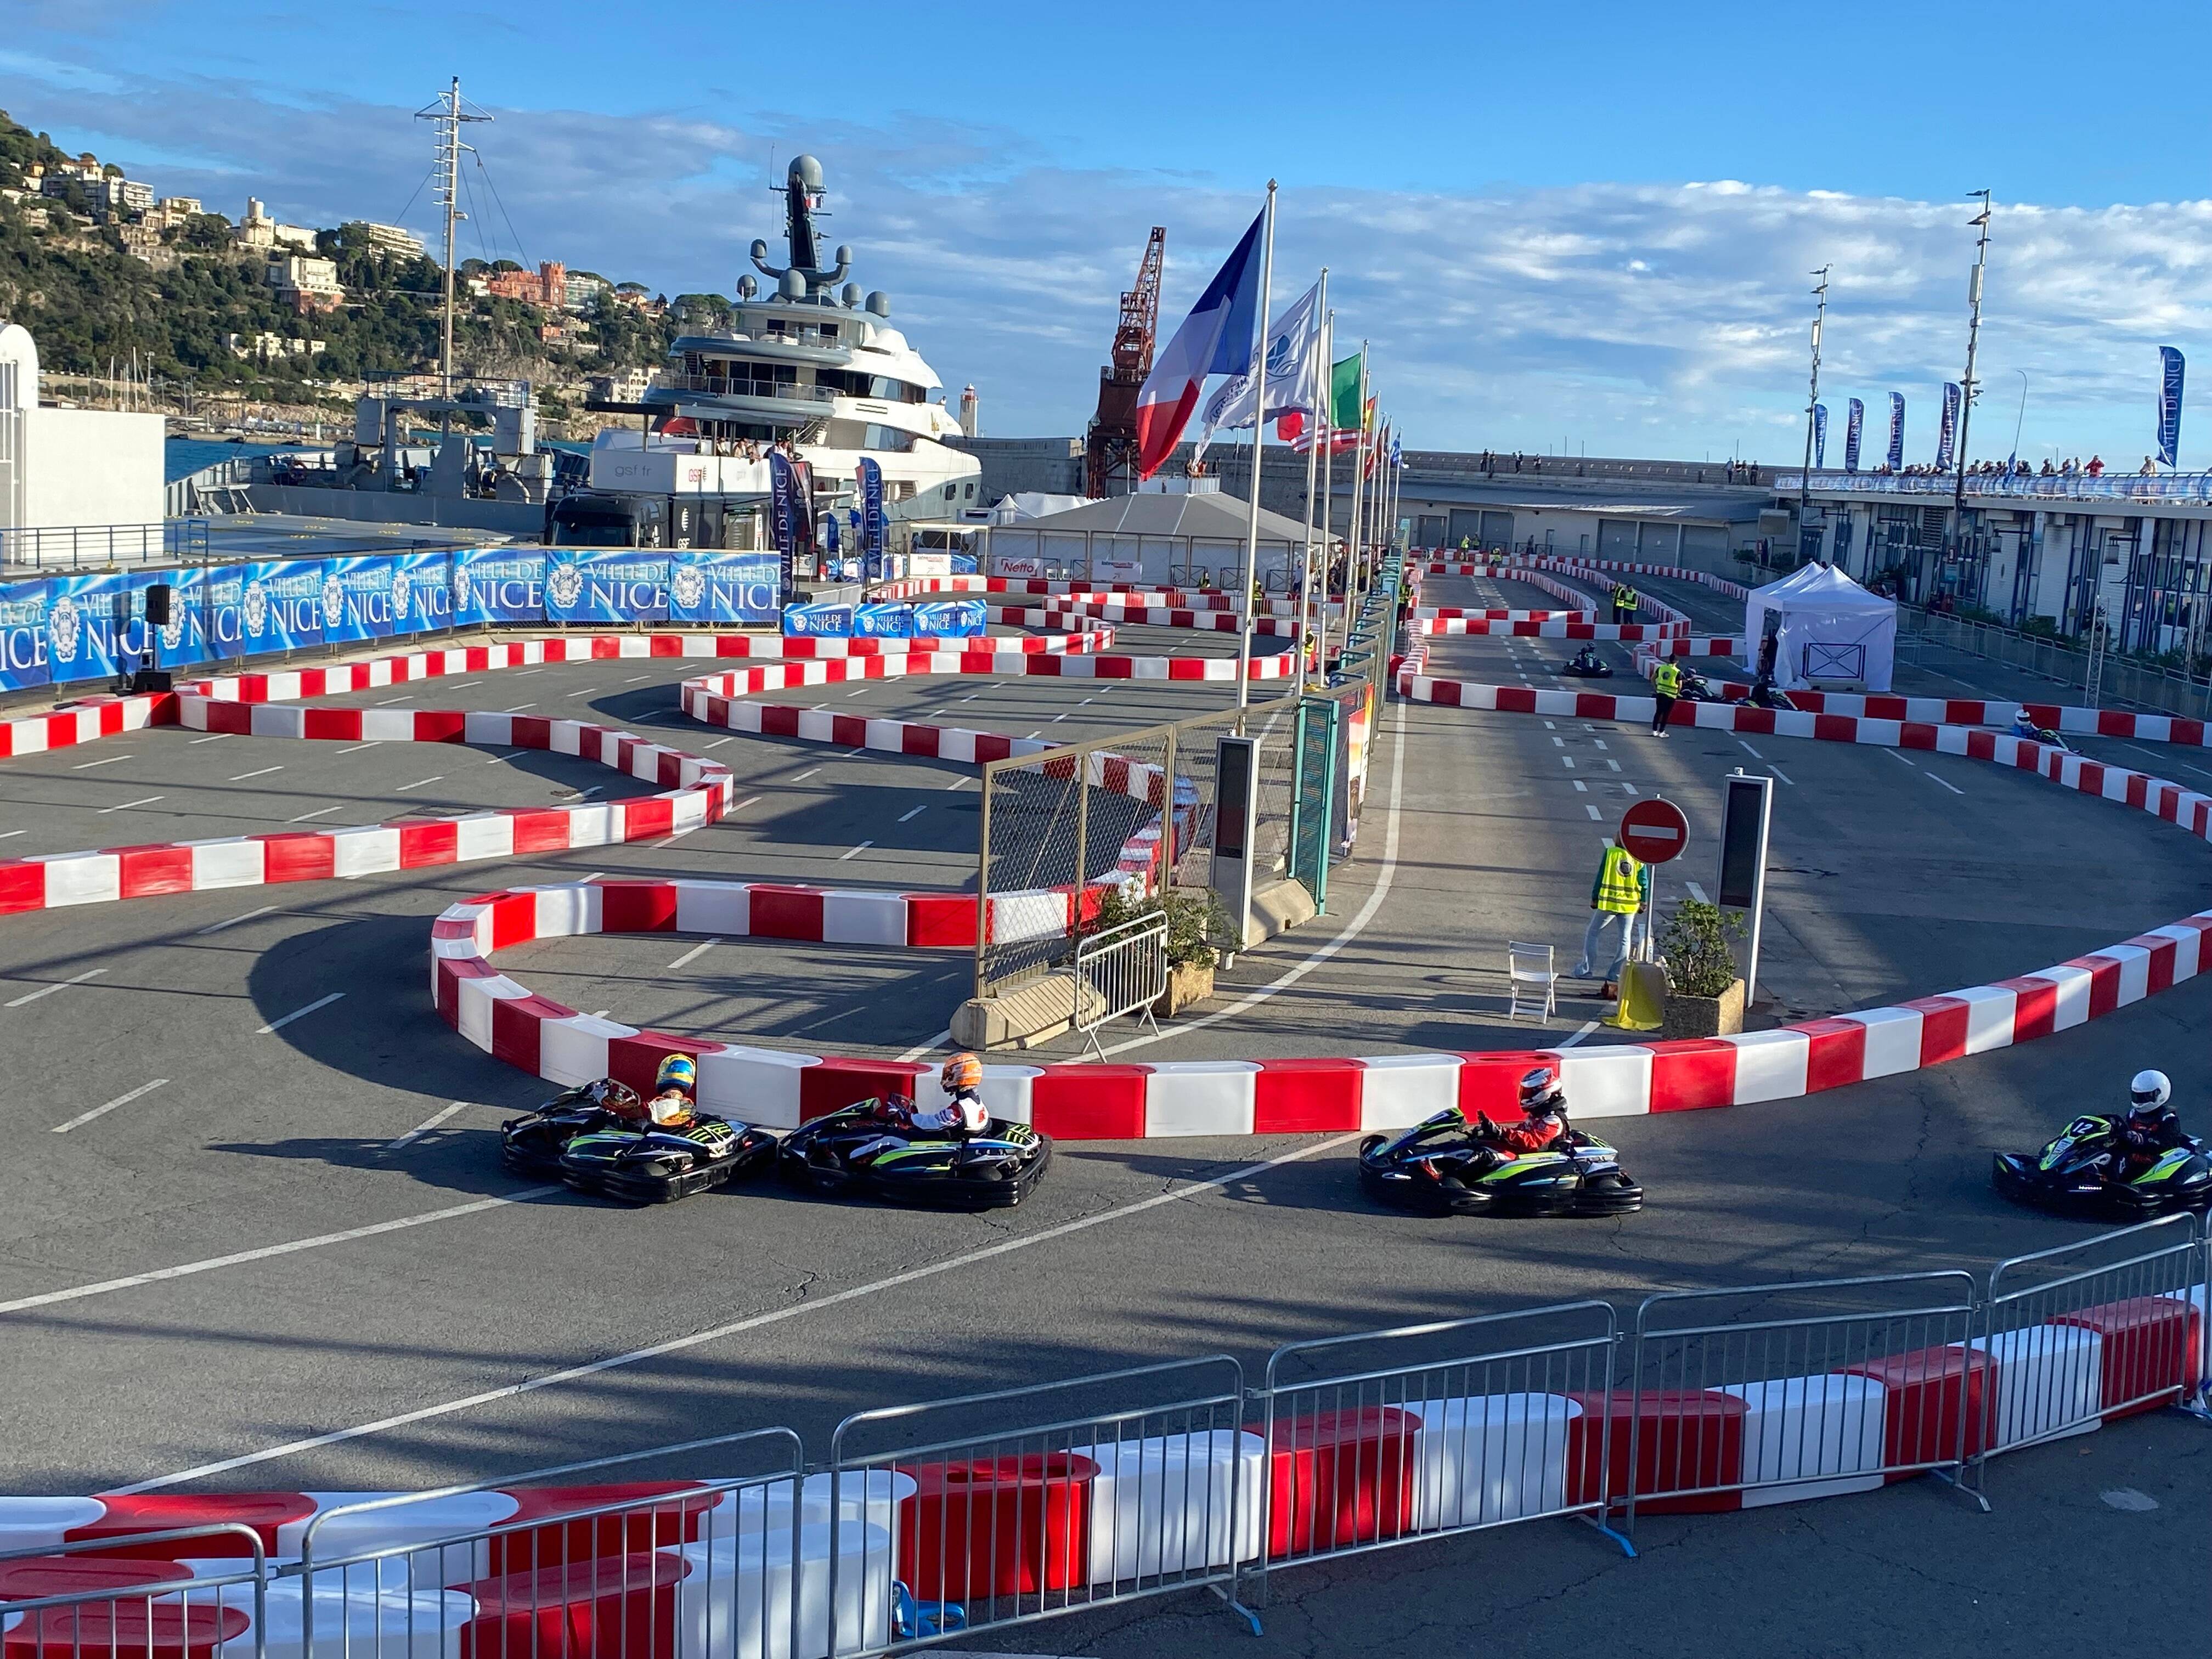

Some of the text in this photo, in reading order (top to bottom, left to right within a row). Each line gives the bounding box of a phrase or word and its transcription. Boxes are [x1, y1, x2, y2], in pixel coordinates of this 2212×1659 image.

[2166, 356, 2182, 389] NICE
[2165, 392, 2179, 411] DE
[867, 465, 879, 501] NICE
[776, 468, 791, 577] VILLE DE NICE
[868, 502, 879, 524] DE
[471, 562, 544, 580] VILLE DE
[588, 563, 669, 580] VILLE DE
[710, 565, 757, 582] VILLE
[1003, 562, 1034, 573] Netto
[268, 574, 321, 599] VILLE DE
[345, 569, 391, 591] VILLE DE
[414, 585, 453, 618] NICE
[472, 579, 544, 610] NICE
[588, 580, 669, 610] NICE
[711, 583, 781, 610] NICE
[271, 596, 321, 636] NICE
[347, 590, 392, 627] NICE
[809, 621, 842, 631] NICE
[876, 621, 905, 632] NICE
[929, 619, 950, 630] NICE
[967, 614, 983, 627] NICE
[0, 625, 48, 672] ICE
[2073, 1122, 2093, 1134] 12
